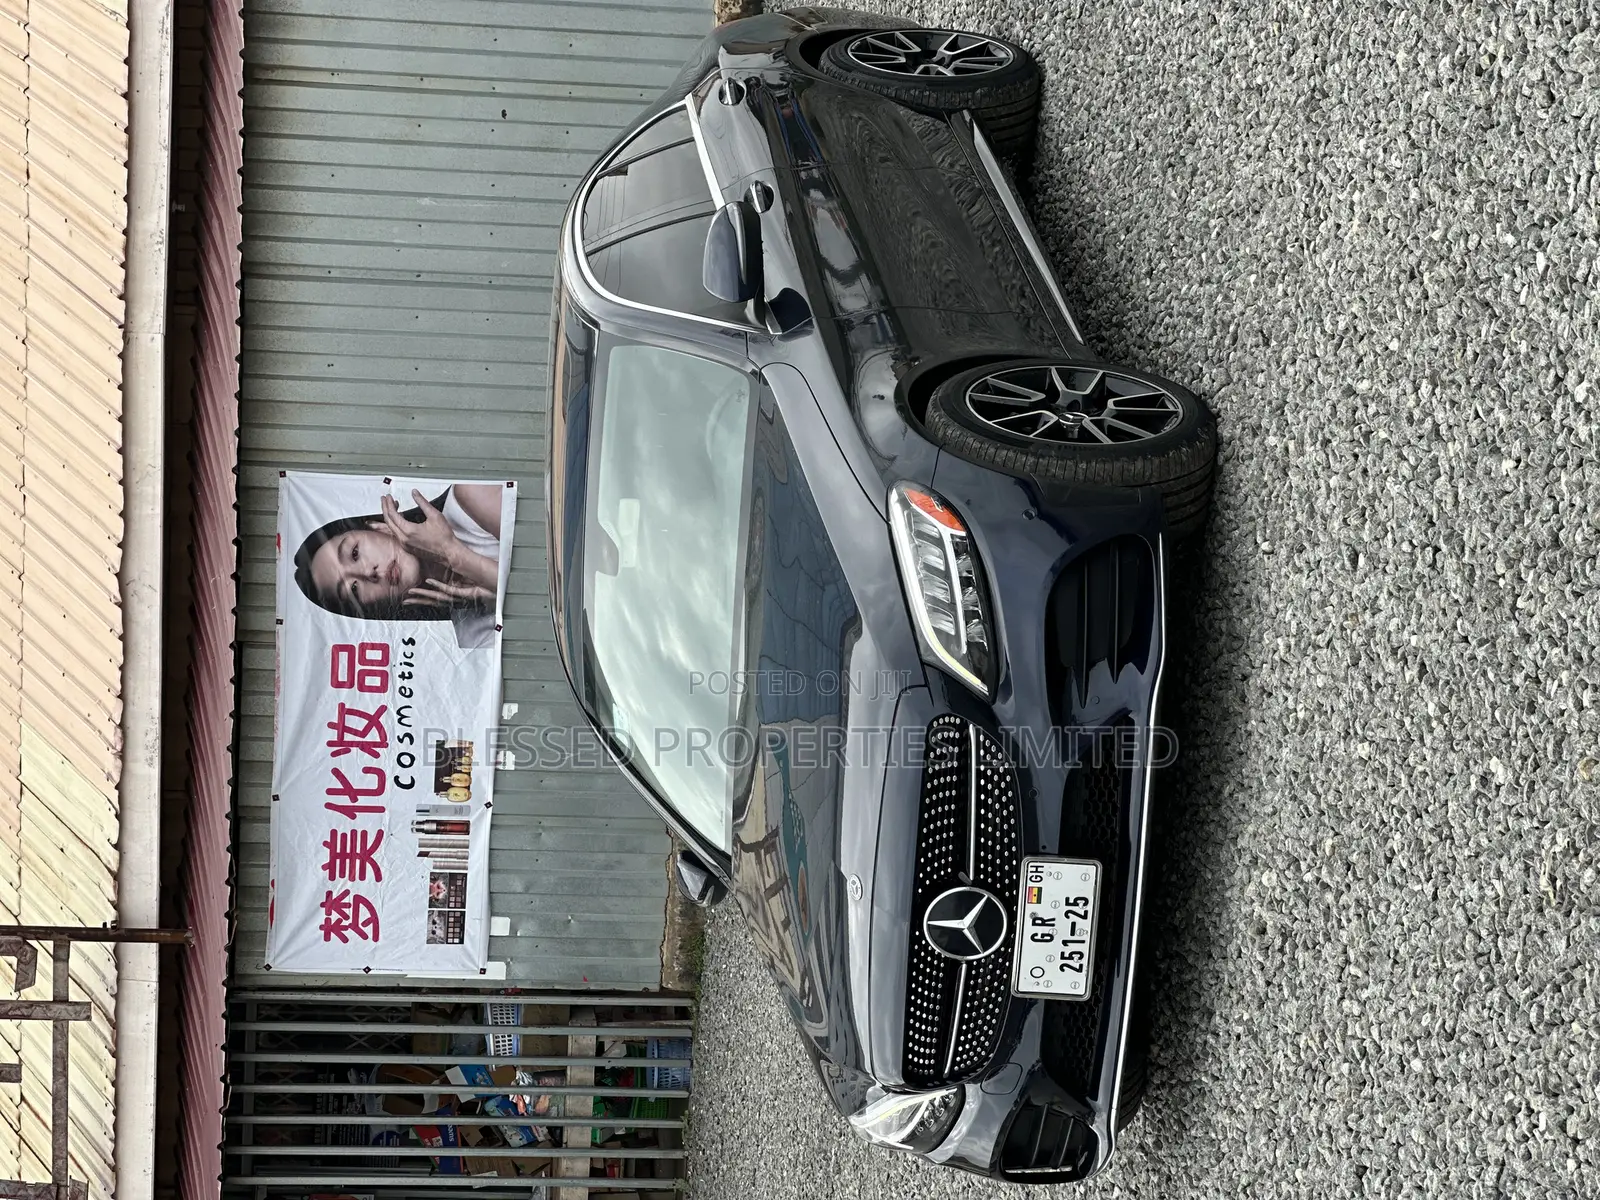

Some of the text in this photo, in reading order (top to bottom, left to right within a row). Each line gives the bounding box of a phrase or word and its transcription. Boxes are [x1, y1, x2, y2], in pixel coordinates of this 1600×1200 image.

[319, 642, 390, 943] 梦美化妆品
[1029, 865, 1044, 883] GH
[1059, 896, 1089, 974] 251-25
